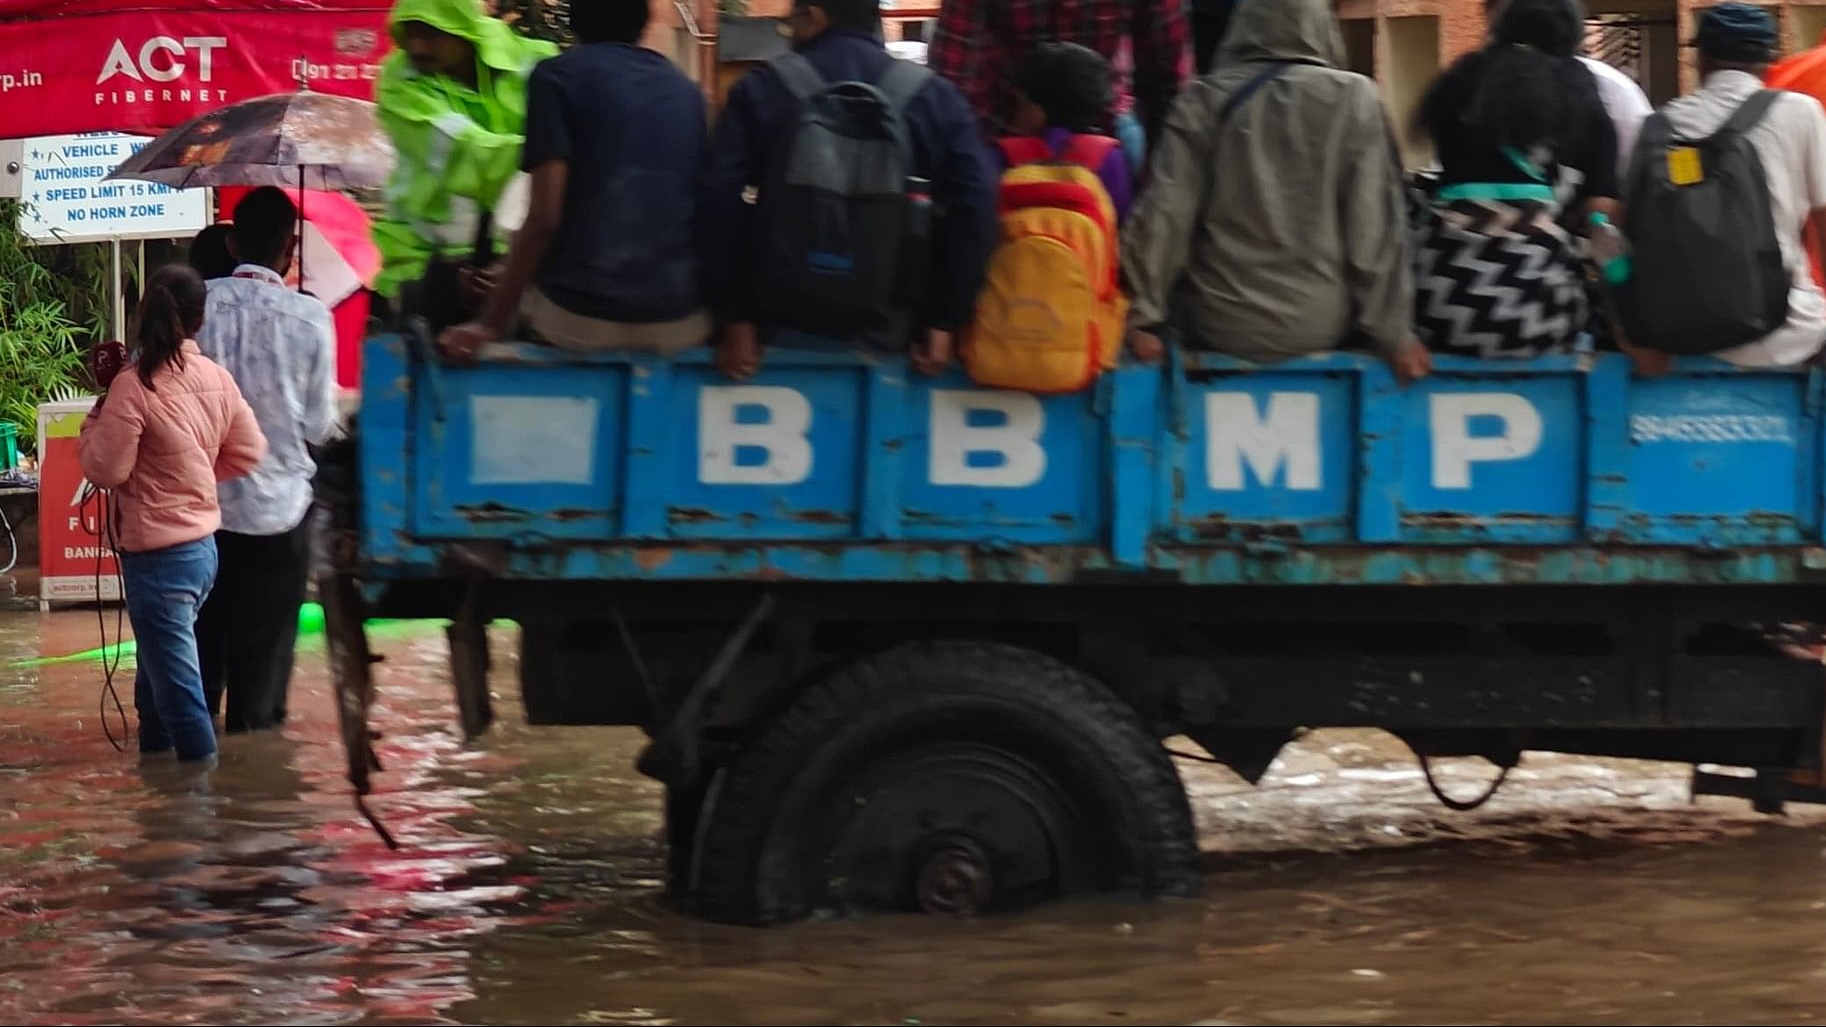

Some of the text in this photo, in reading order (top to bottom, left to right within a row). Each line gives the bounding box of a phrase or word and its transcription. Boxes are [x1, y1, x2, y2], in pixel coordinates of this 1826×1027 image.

[96, 36, 227, 85] ACT
[0, 69, 42, 92] p.in
[95, 89, 227, 104] FIBERNET
[62, 144, 119, 158] VEHICLE
[34, 167, 104, 181] AUTHORISED
[46, 182, 184, 201] SPEED LIMIT 15 KM
[67, 204, 165, 221] NO HORN ZONE
[64, 547, 114, 559] BANGA
